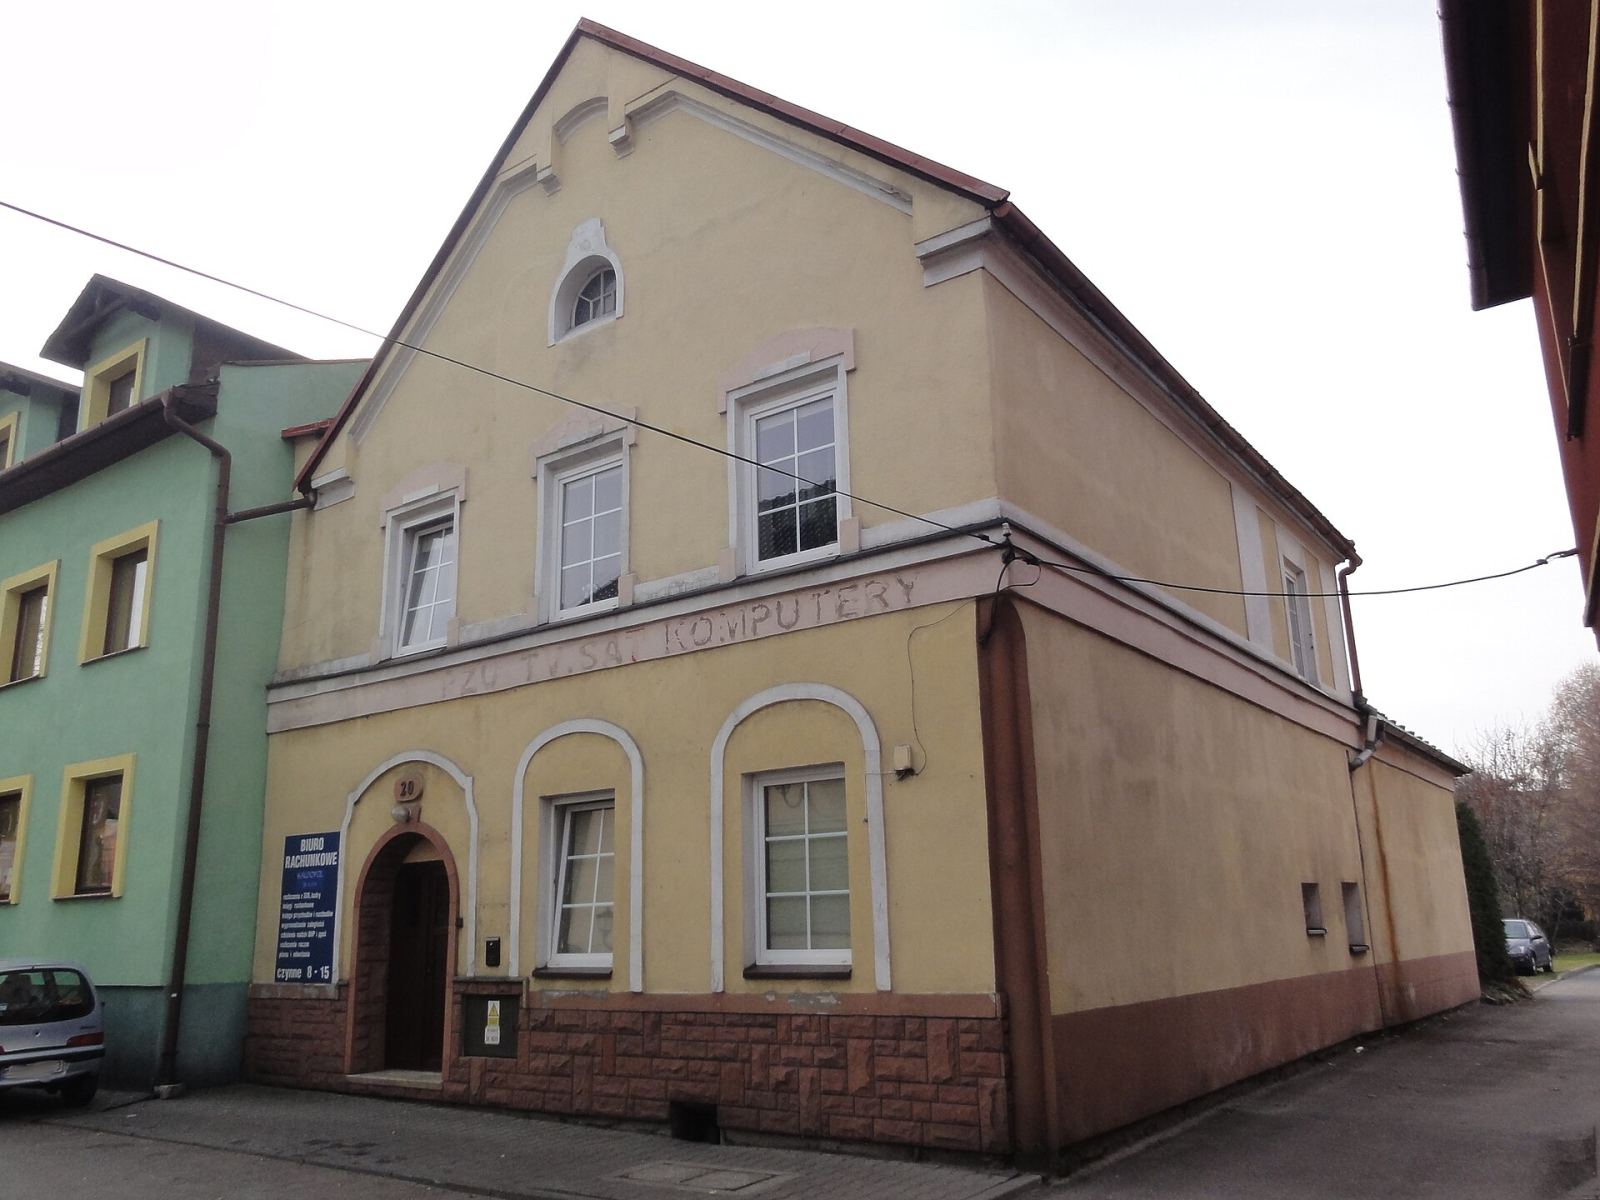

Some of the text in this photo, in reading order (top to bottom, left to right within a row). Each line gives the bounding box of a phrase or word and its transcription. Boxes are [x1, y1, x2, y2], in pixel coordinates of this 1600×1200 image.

[664, 574, 919, 655] KOMPUTERY
[400, 781, 415, 796] 20
[300, 837, 324, 851] BIURO
[284, 851, 338, 869] RACHUNKOWE
[276, 968, 302, 981] czynne
[306, 965, 313, 979] 8
[320, 965, 330, 979] 15
